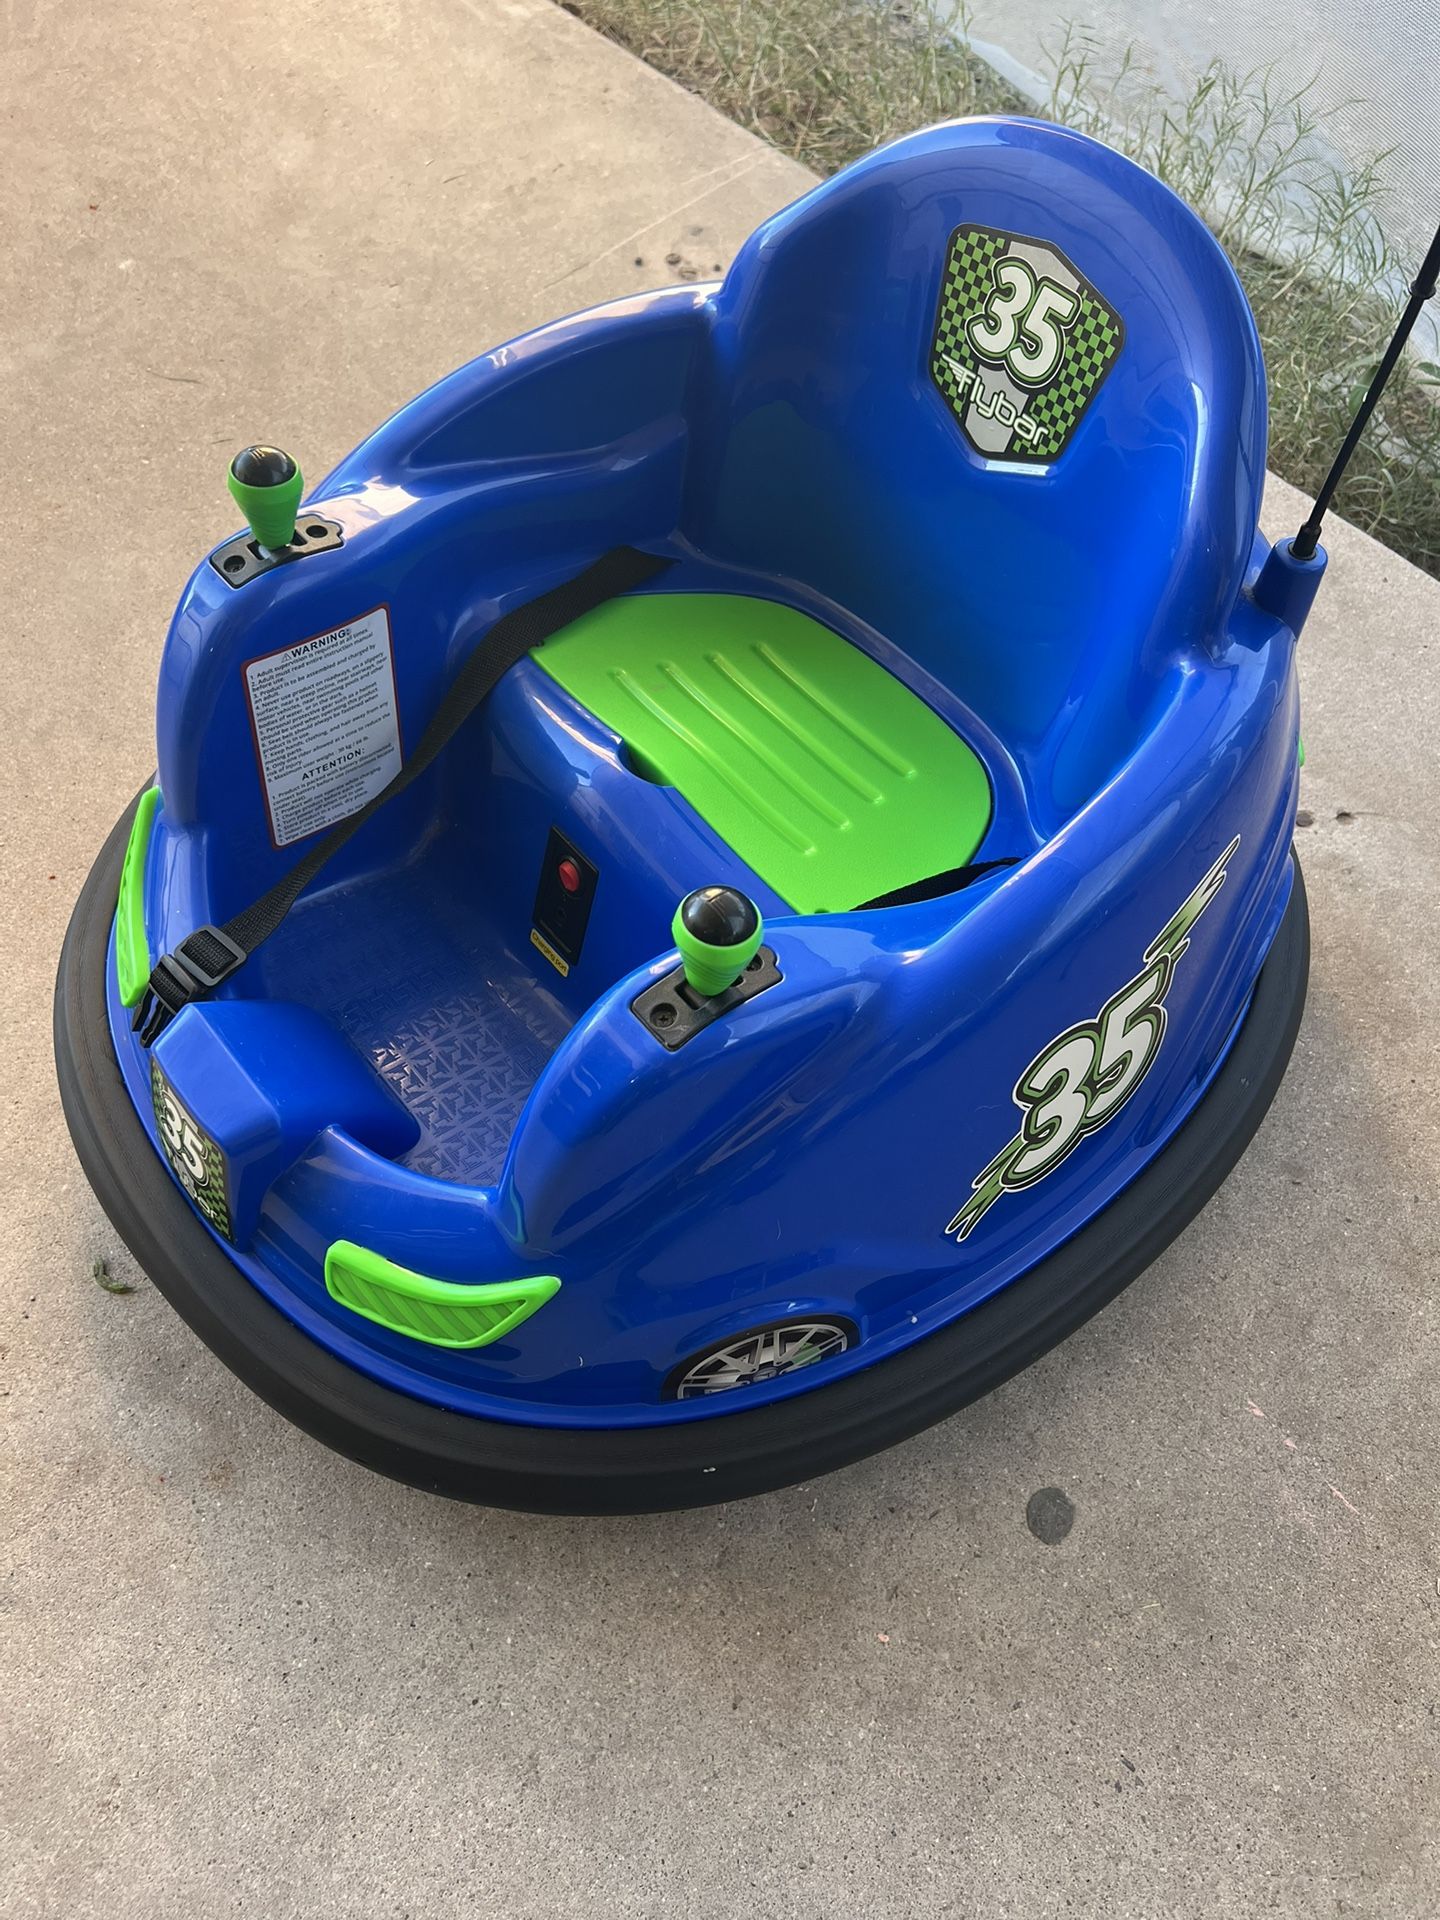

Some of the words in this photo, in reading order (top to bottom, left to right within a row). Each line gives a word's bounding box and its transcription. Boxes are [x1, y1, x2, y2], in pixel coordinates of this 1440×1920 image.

[969, 261, 1079, 382] 35
[956, 370, 1049, 445] Flybar
[259, 682, 283, 696] Product
[305, 660, 336, 678] assembled
[347, 645, 368, 660] charged
[291, 627, 349, 656] WARNING:
[302, 747, 365, 780] ATTENTION:
[1006, 962, 1166, 1182] 35
[162, 1093, 206, 1183] 35
